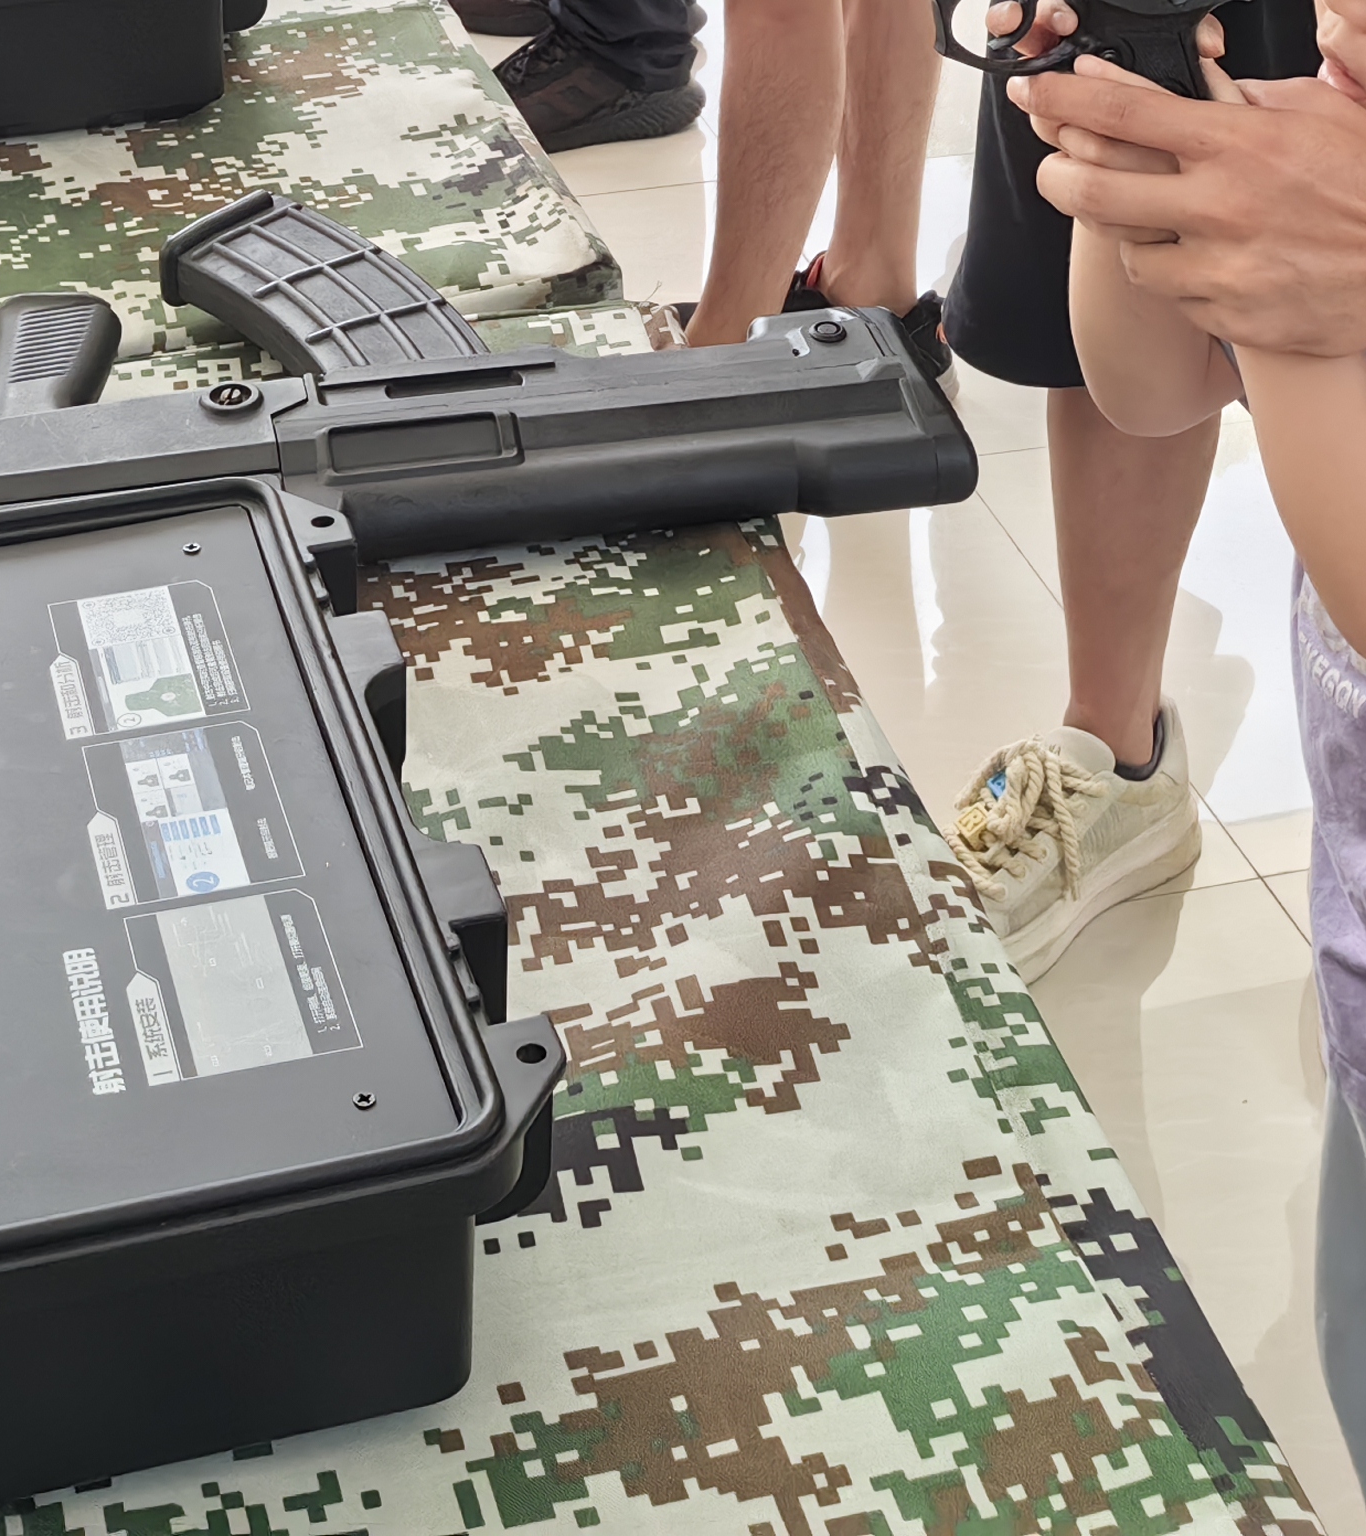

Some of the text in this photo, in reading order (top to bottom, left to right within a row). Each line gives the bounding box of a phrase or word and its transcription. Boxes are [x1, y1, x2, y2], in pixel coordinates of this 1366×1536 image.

[94, 832, 130, 906] 2 射击管理
[62, 947, 127, 1096] 射击使用说明
[135, 997, 169, 1061] 系统安装
